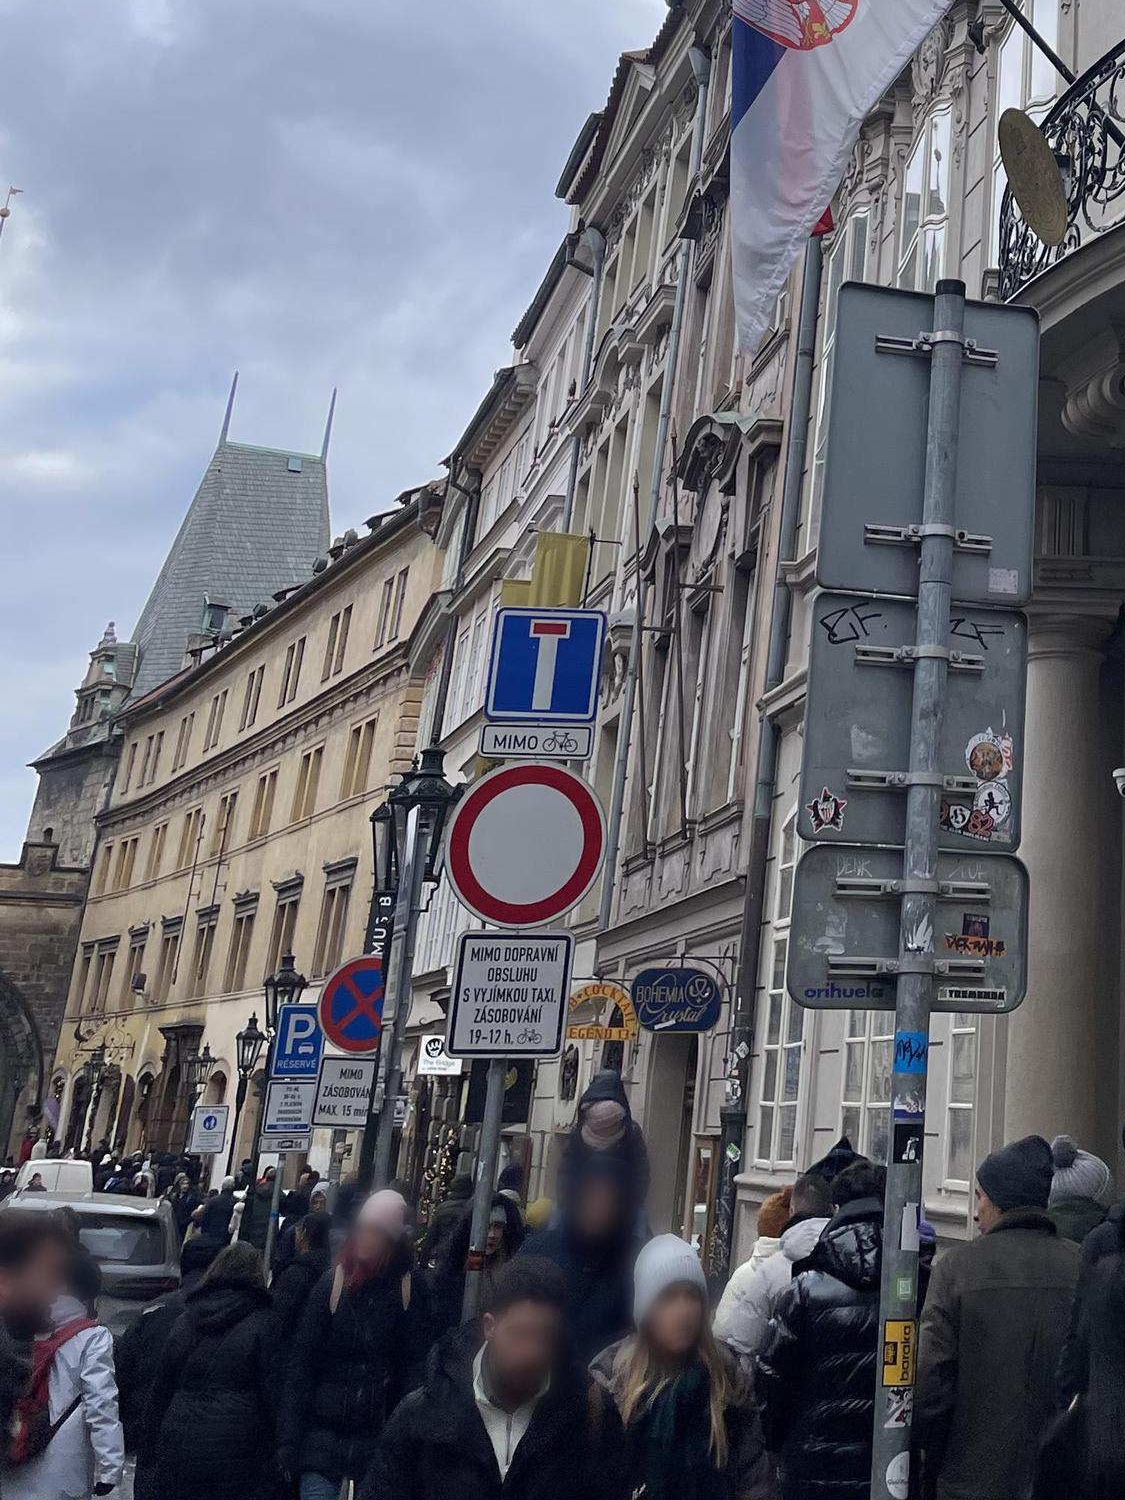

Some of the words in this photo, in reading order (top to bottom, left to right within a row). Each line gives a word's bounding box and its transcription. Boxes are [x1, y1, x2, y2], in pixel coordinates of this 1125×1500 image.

[493, 733, 539, 750] MIMO
[470, 947, 501, 962] MIMO
[504, 944, 560, 962] DOPRAVNÍ
[487, 967, 538, 982] OBSLUHU
[462, 987, 471, 1002] S
[473, 984, 529, 1002] VYJÍMKOU
[636, 985, 685, 1004] BOHEMIA
[804, 982, 883, 999] orihuela
[584, 984, 636, 1025] COCKTAIL
[473, 1005, 543, 1023] ZÁSOBOVÁNÍ
[469, 1029, 502, 1044] 19-12
[569, 1027, 612, 1039] EGEND
[276, 1058, 317, 1069] RÉSERVÉ
[339, 1068, 363, 1080] MIMO
[322, 1084, 371, 1098] ZÁSOBOVÁN
[342, 1105, 352, 1117] 15
[899, 1326, 911, 1381] baraka
